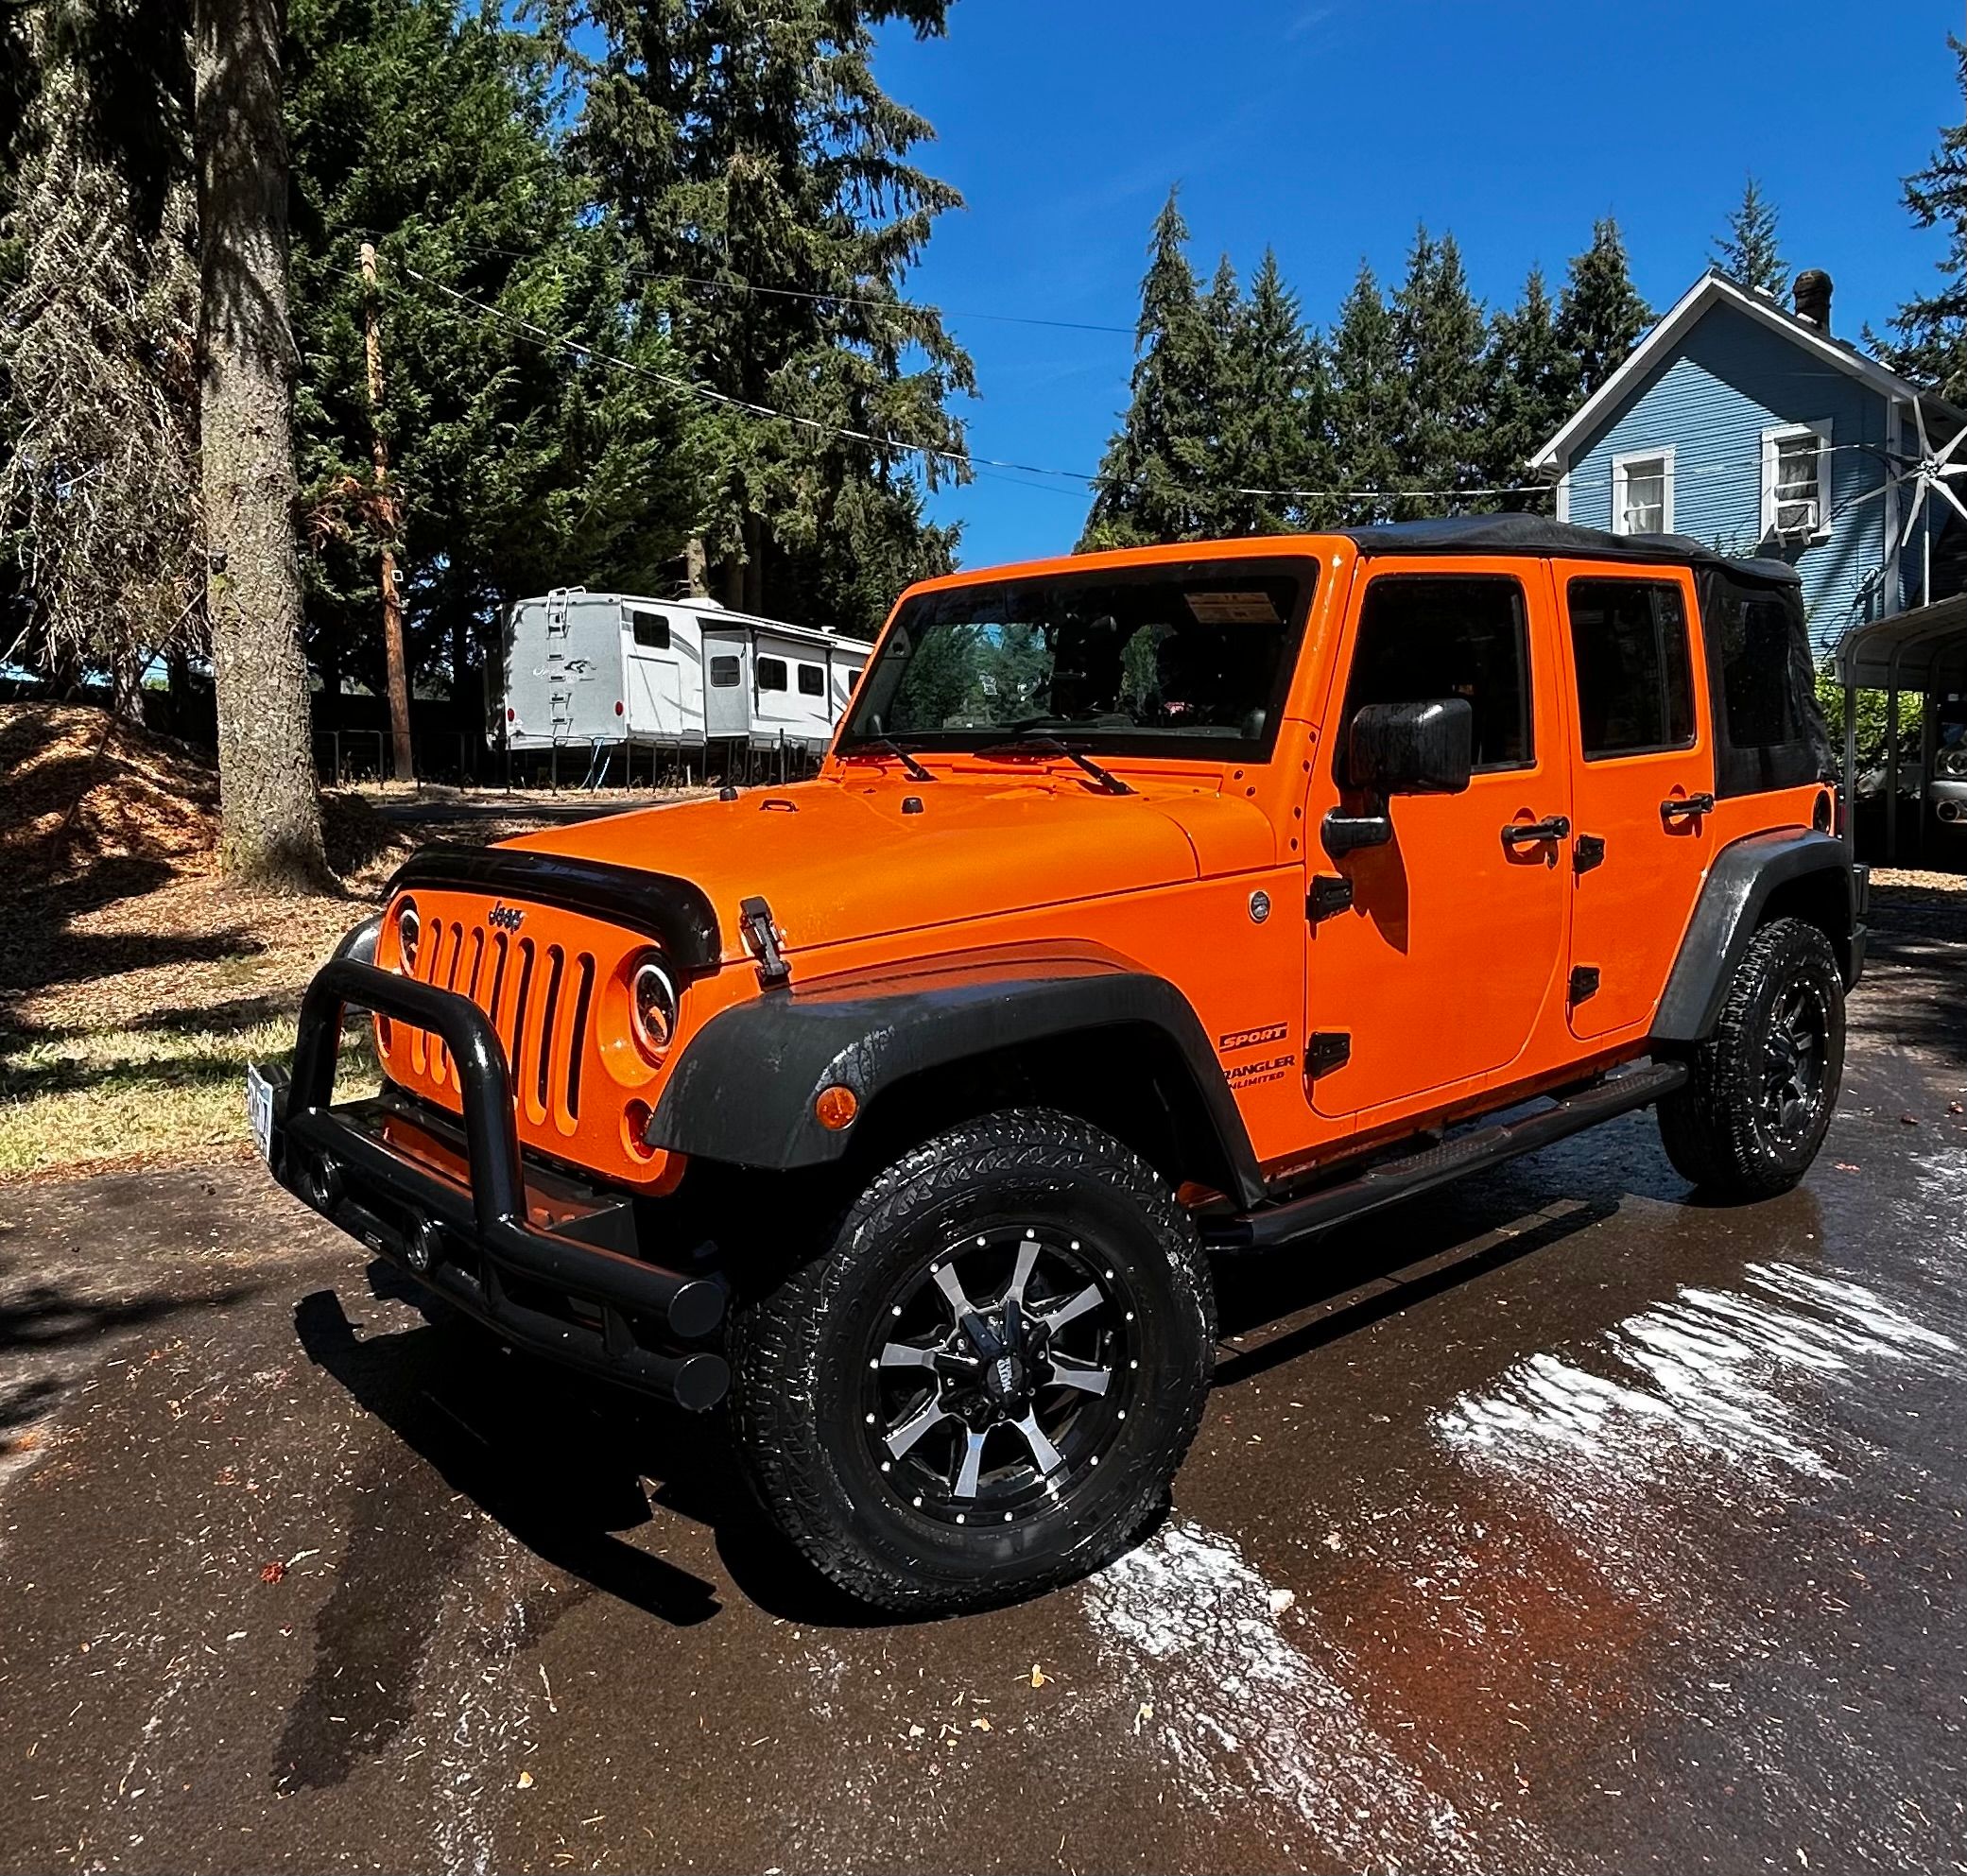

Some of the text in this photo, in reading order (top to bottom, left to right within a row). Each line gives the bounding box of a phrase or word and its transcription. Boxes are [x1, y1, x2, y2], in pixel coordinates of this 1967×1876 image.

[488, 900, 524, 935] Jeep
[1220, 1025, 1287, 1048] SPORT
[1224, 1054, 1295, 1079] RANGLER
[1230, 1071, 1285, 1090] NLIMITED
